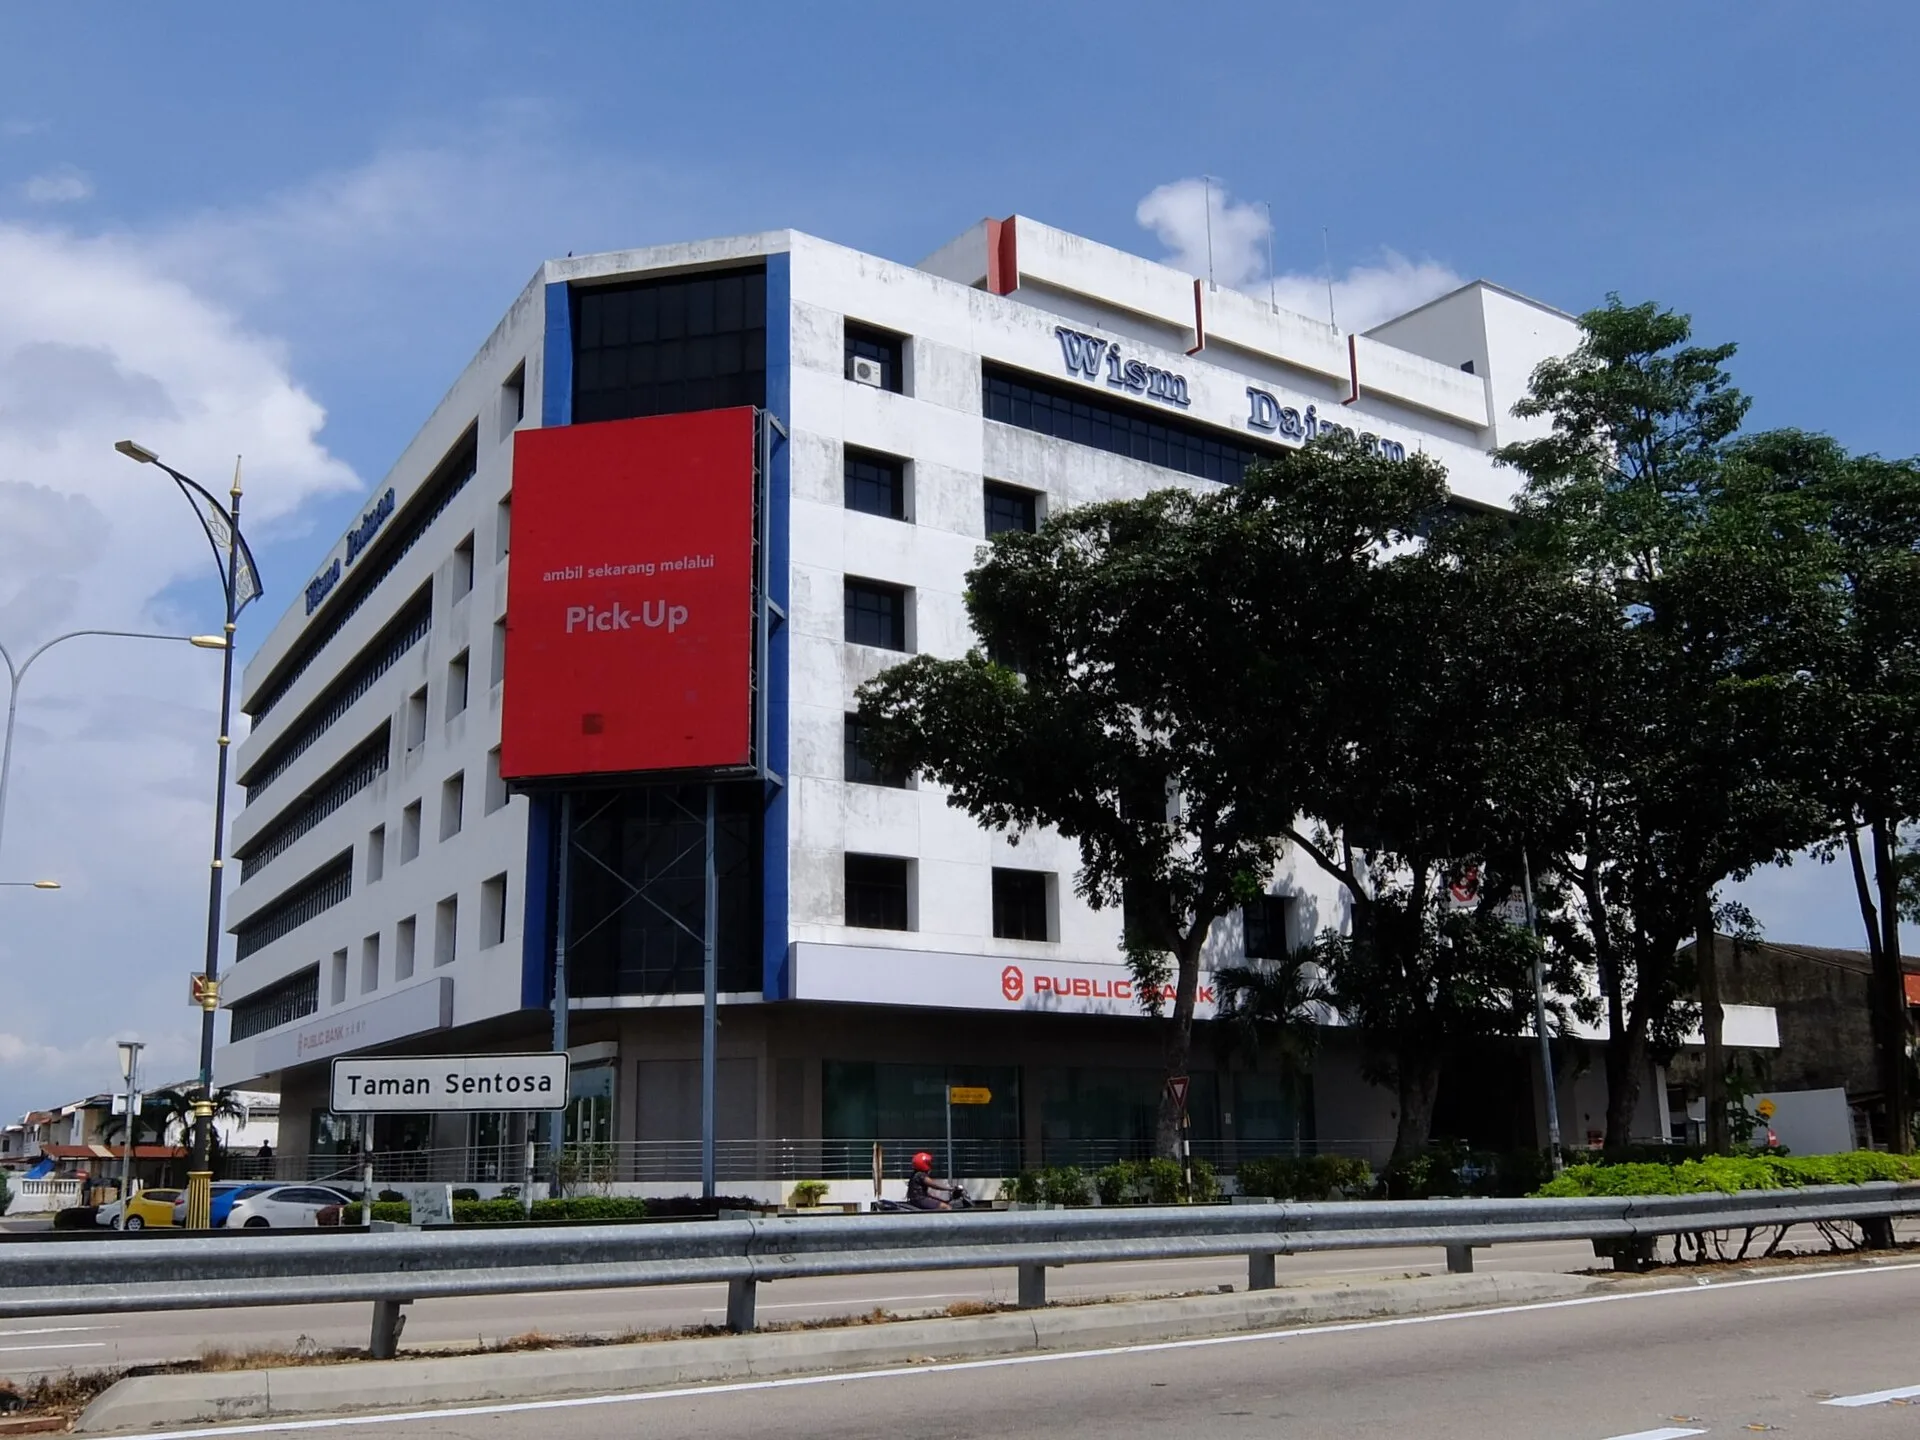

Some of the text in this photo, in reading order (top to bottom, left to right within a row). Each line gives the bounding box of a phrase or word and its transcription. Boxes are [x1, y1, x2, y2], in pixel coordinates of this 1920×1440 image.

[1055, 326, 1191, 406] Wism
[543, 554, 715, 582] ambil sekarang melalui
[566, 599, 688, 634] Pick-Up
[1034, 976, 1215, 1003] PUBLIC AK
[347, 1074, 552, 1096] Taman Sentosa
